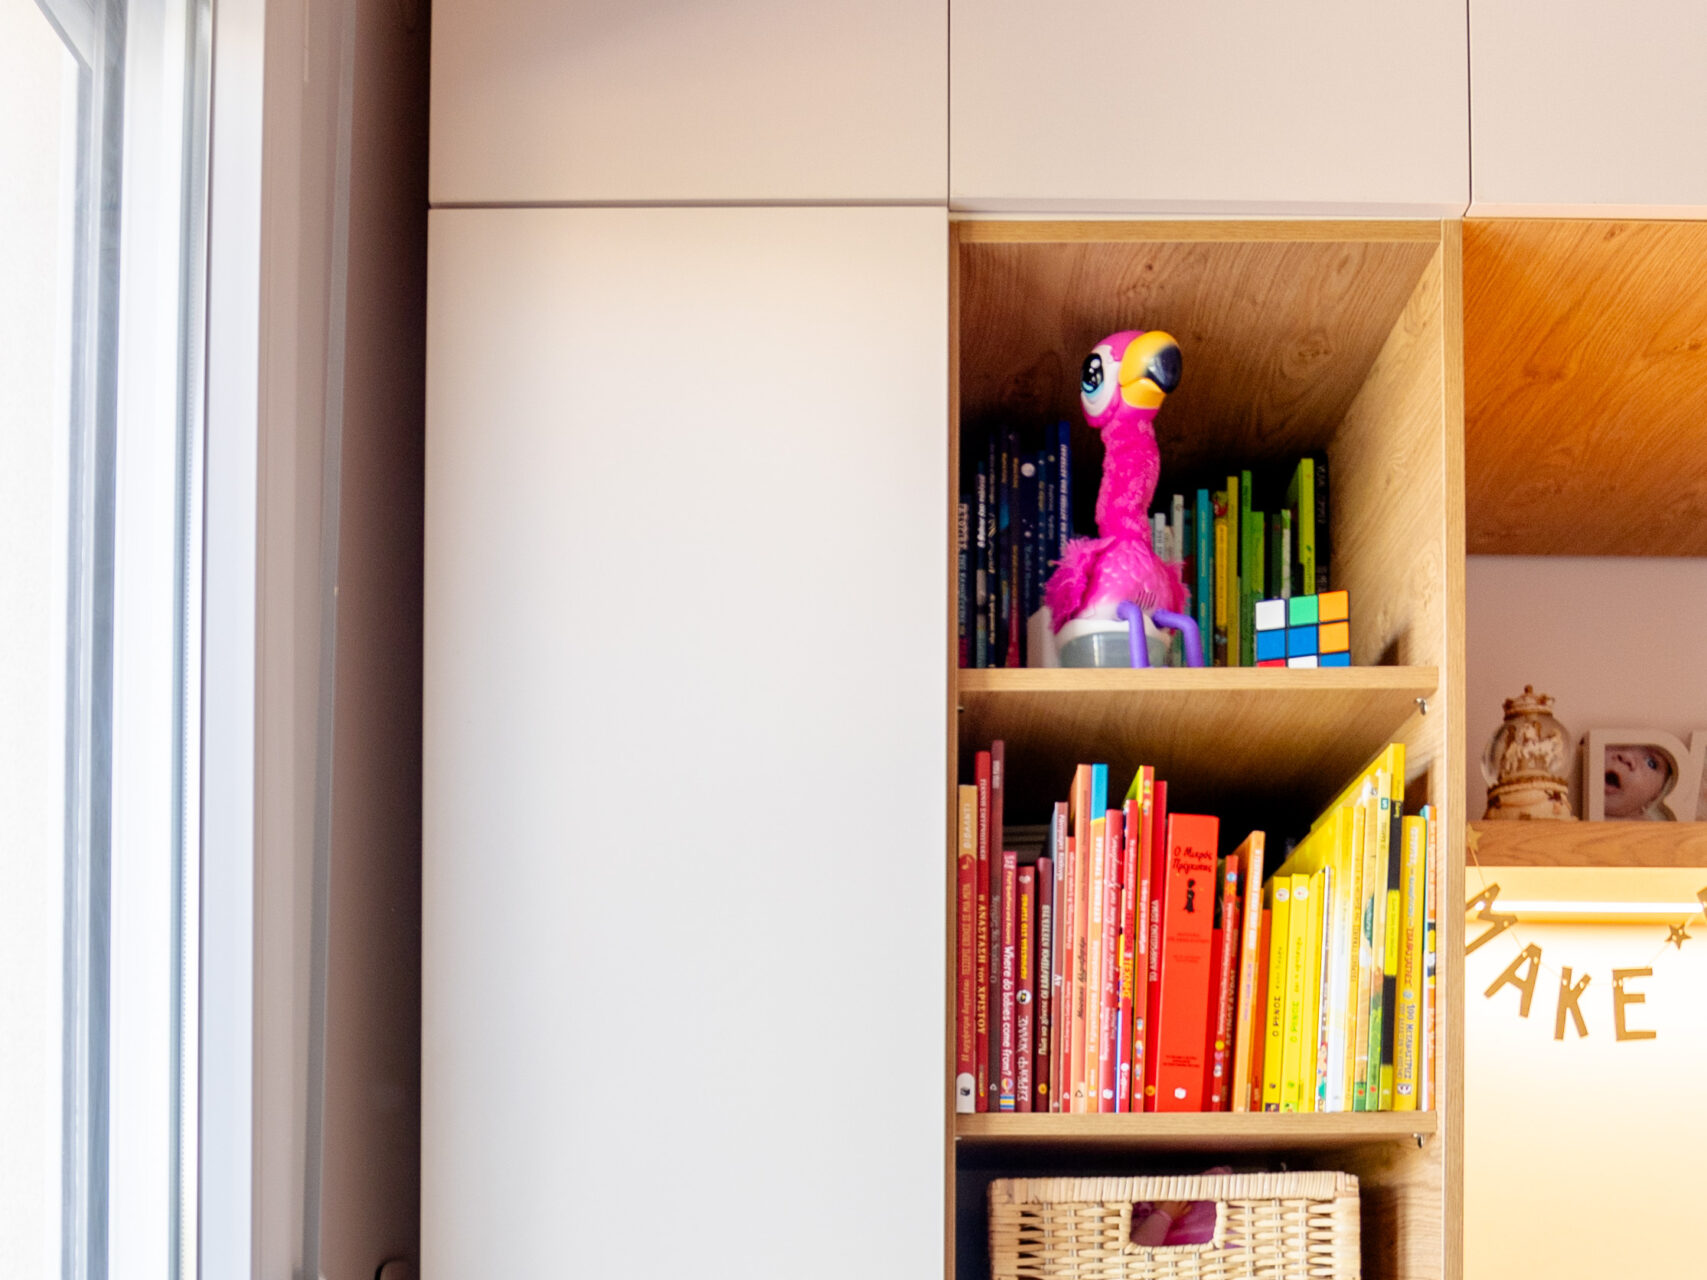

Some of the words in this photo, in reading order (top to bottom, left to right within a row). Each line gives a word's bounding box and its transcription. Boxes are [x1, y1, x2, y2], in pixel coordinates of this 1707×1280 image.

[1174, 845, 1182, 857] Ο
[1183, 846, 1212, 862] Μικρός
[1002, 945, 1015, 978] Where
[1465, 883, 1657, 1041] MAKE
[1002, 979, 1013, 991] do
[1002, 991, 1013, 1021] babies
[1002, 1022, 1011, 1048] come
[1001, 1049, 1012, 1076] from?
